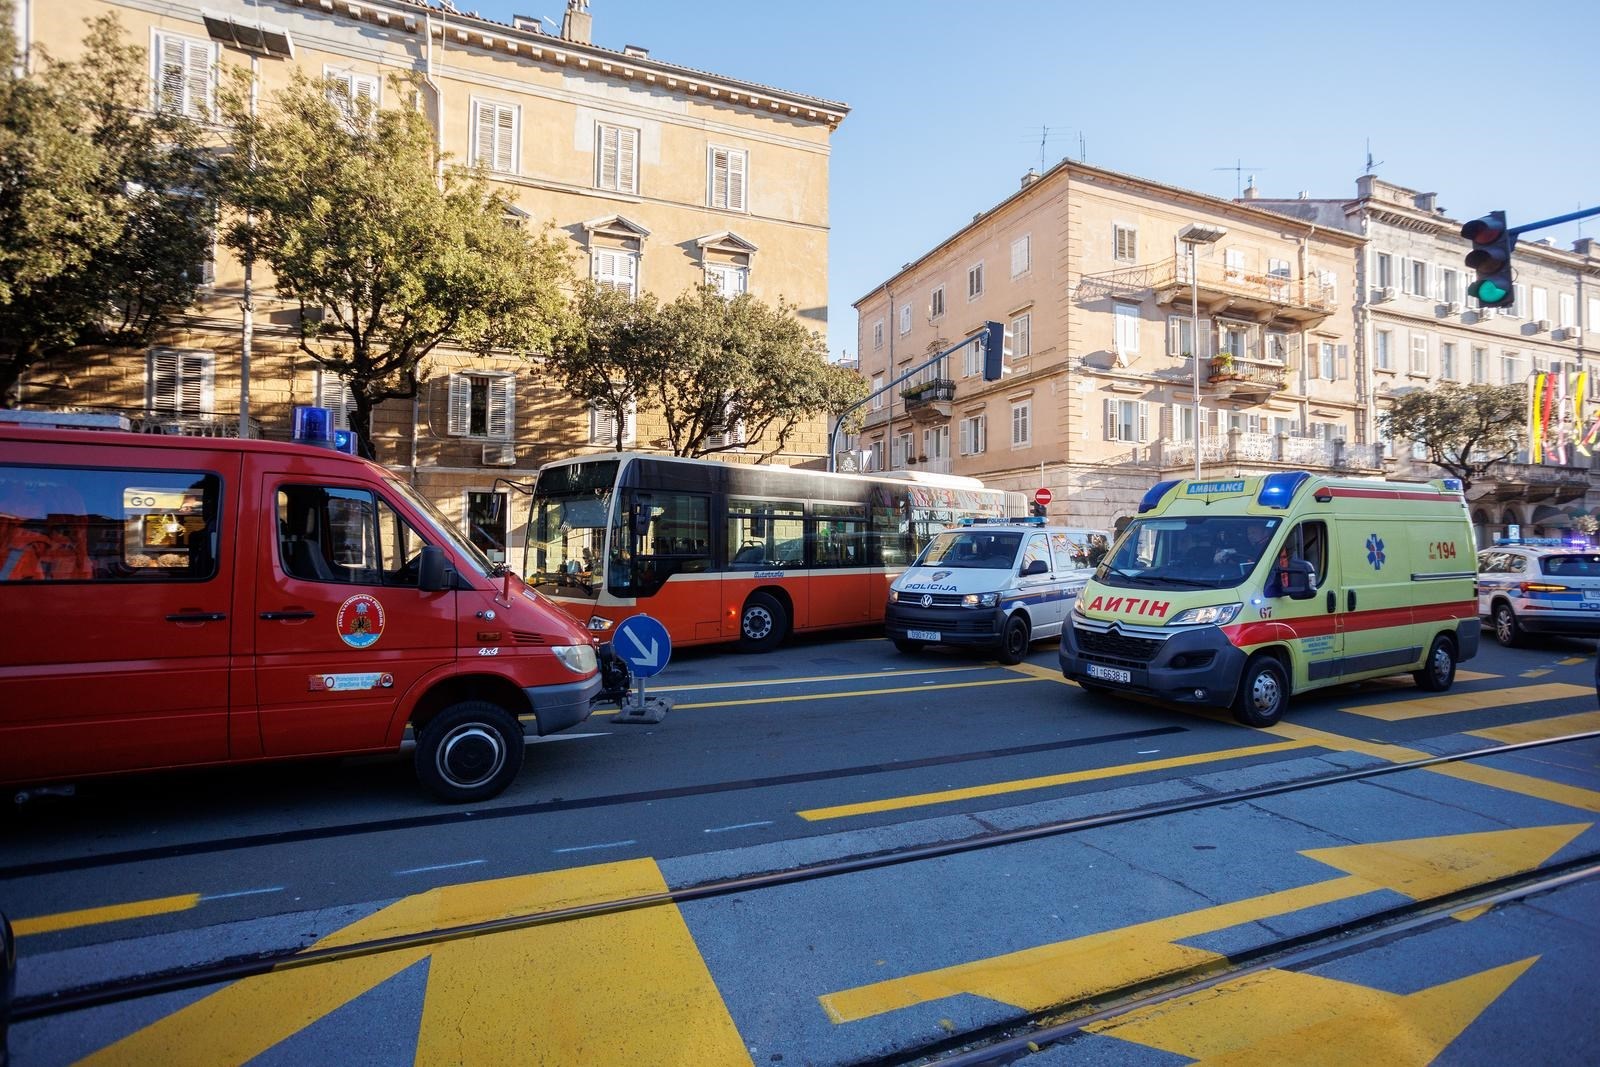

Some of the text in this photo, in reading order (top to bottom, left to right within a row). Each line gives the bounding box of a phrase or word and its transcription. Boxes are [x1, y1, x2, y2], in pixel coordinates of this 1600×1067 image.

[1188, 482, 1244, 493] AMBULANCE
[131, 496, 156, 507] GO
[1437, 541, 1457, 559] 194
[904, 583, 958, 592] POLICIJA
[1260, 606, 1273, 619] 67
[479, 647, 499, 656] 4x4
